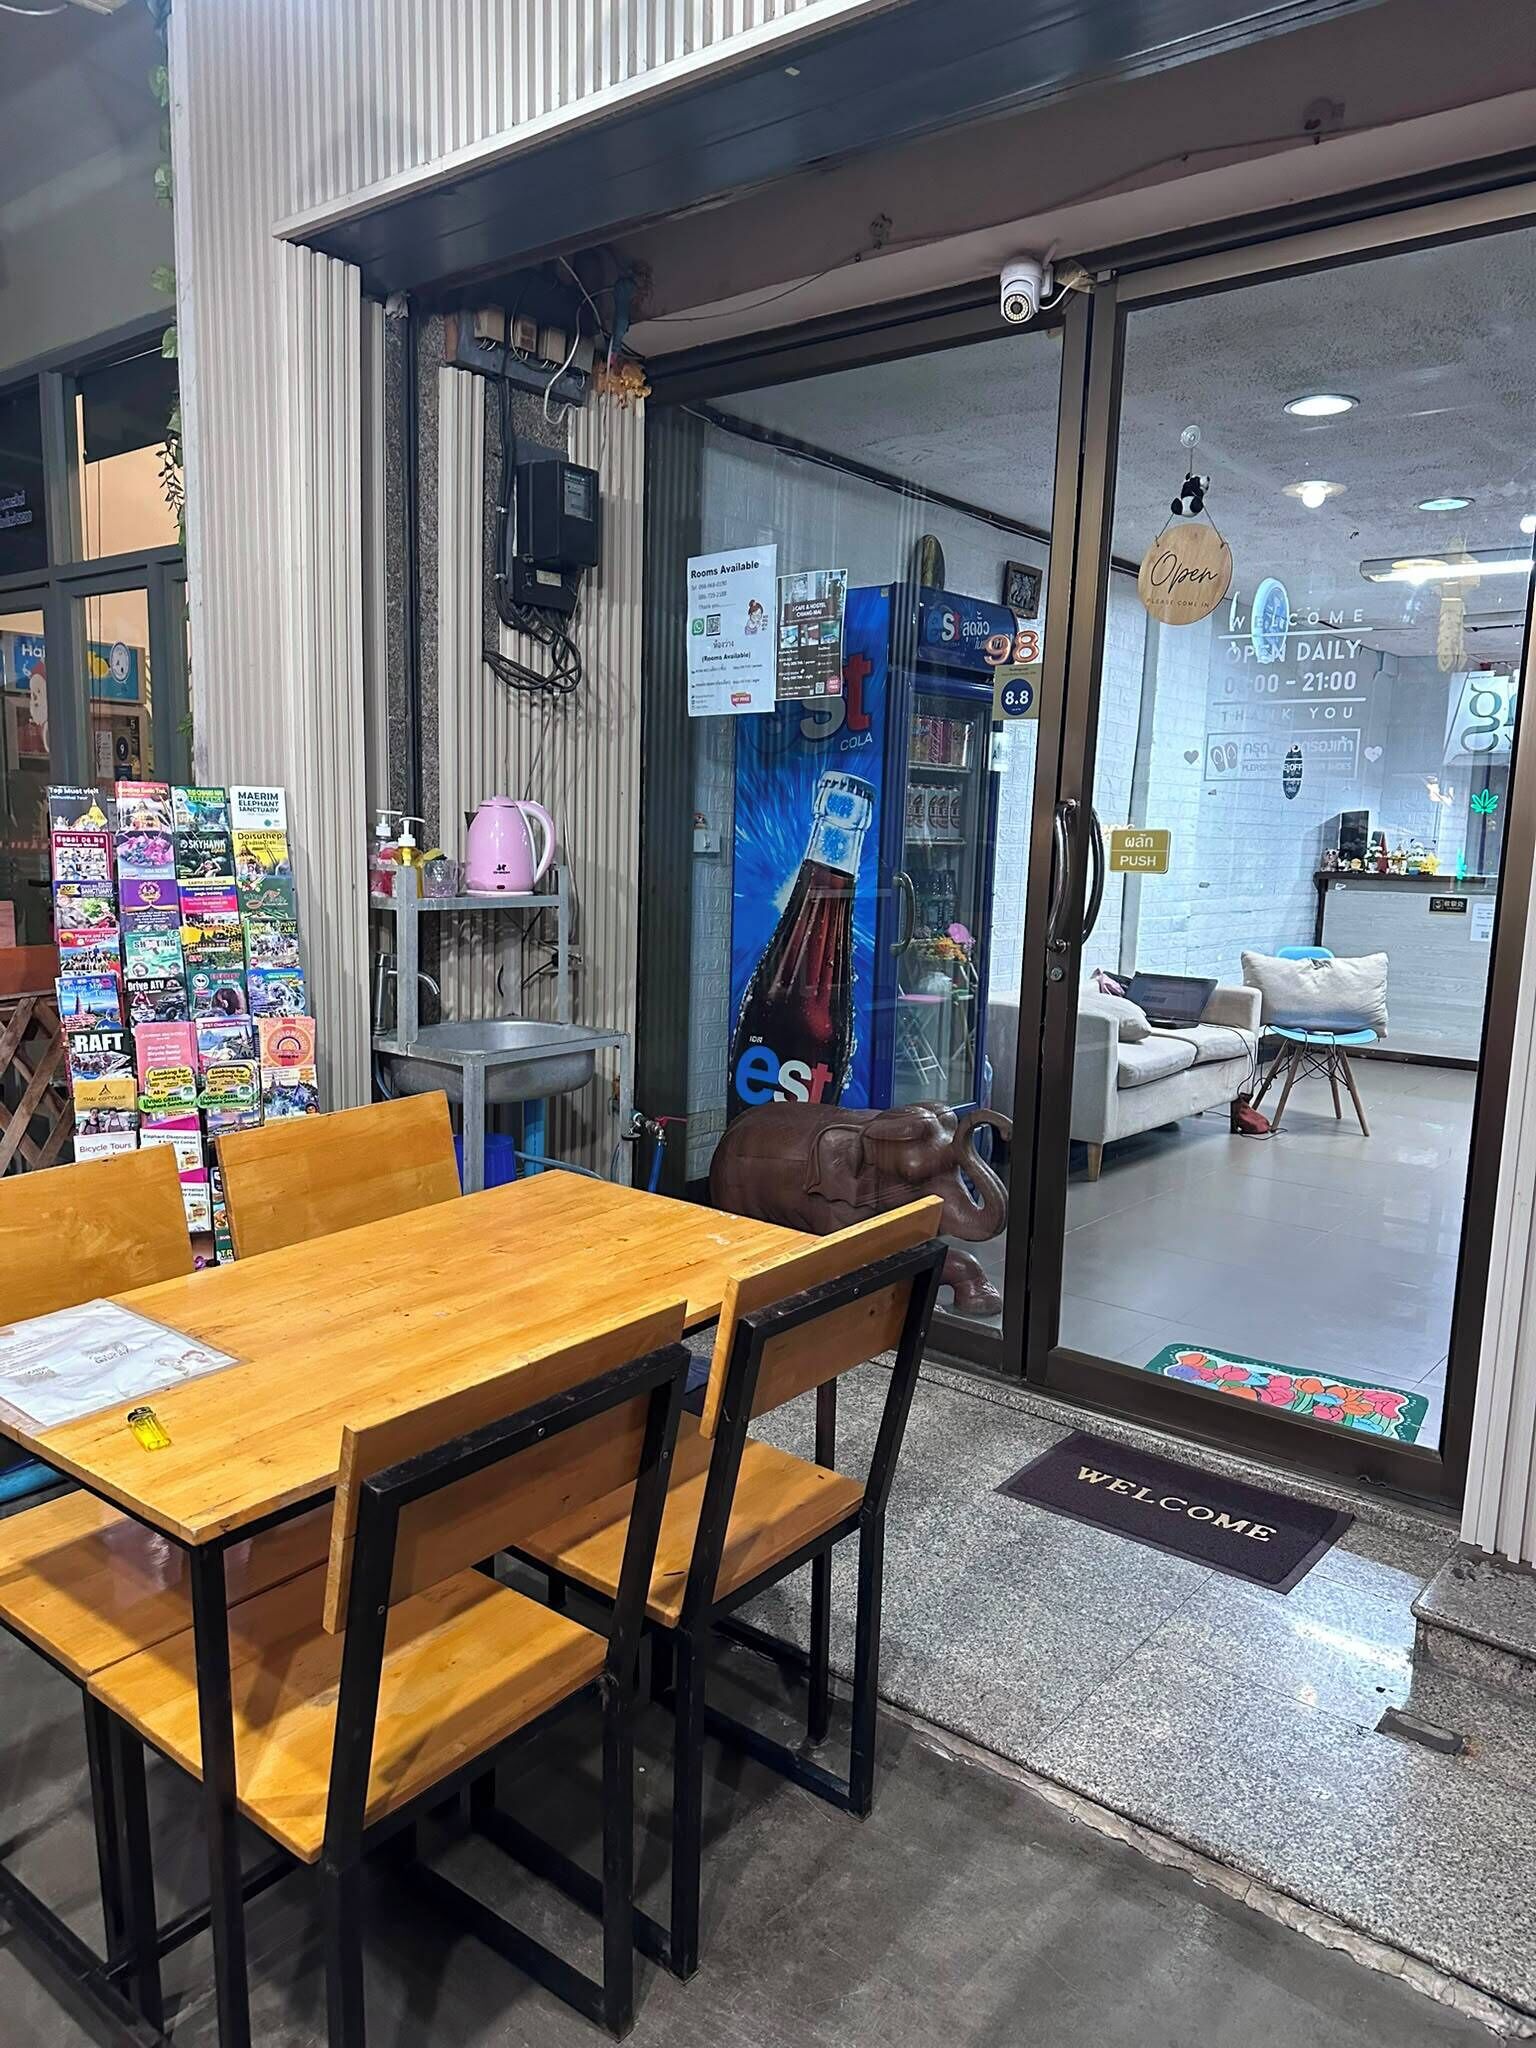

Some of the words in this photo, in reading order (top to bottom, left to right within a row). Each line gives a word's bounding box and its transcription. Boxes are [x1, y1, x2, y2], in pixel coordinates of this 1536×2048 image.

[690, 568, 718, 579] Rooms
[720, 560, 760, 574] Available
[1150, 550, 1218, 594] Open
[1230, 608, 1364, 631] WELCOME
[984, 630, 1039, 667] 98
[1225, 641, 1287, 664] OPEN
[1296, 639, 1362, 662] DAILY
[1302, 671, 1357, 692] 21:00
[1005, 690, 1029, 705] 8.8
[1309, 706, 1353, 720] YOU
[840, 732, 873, 751] COLA
[238, 791, 279, 801] MAERIM
[188, 839, 226, 849] SKYHAWK
[1124, 833, 1154, 848] ผลัก
[1119, 855, 1157, 867] PUSH
[127, 980, 149, 991] Drive
[150, 979, 165, 989] ATV
[74, 1033, 124, 1053] RAFT
[736, 1045, 833, 1105] est
[168, 1100, 194, 1108] Sanctuary
[79, 1143, 108, 1154] Bicycle
[111, 1142, 132, 1150] Tours
[1075, 1465, 1277, 1543] WELCOME
